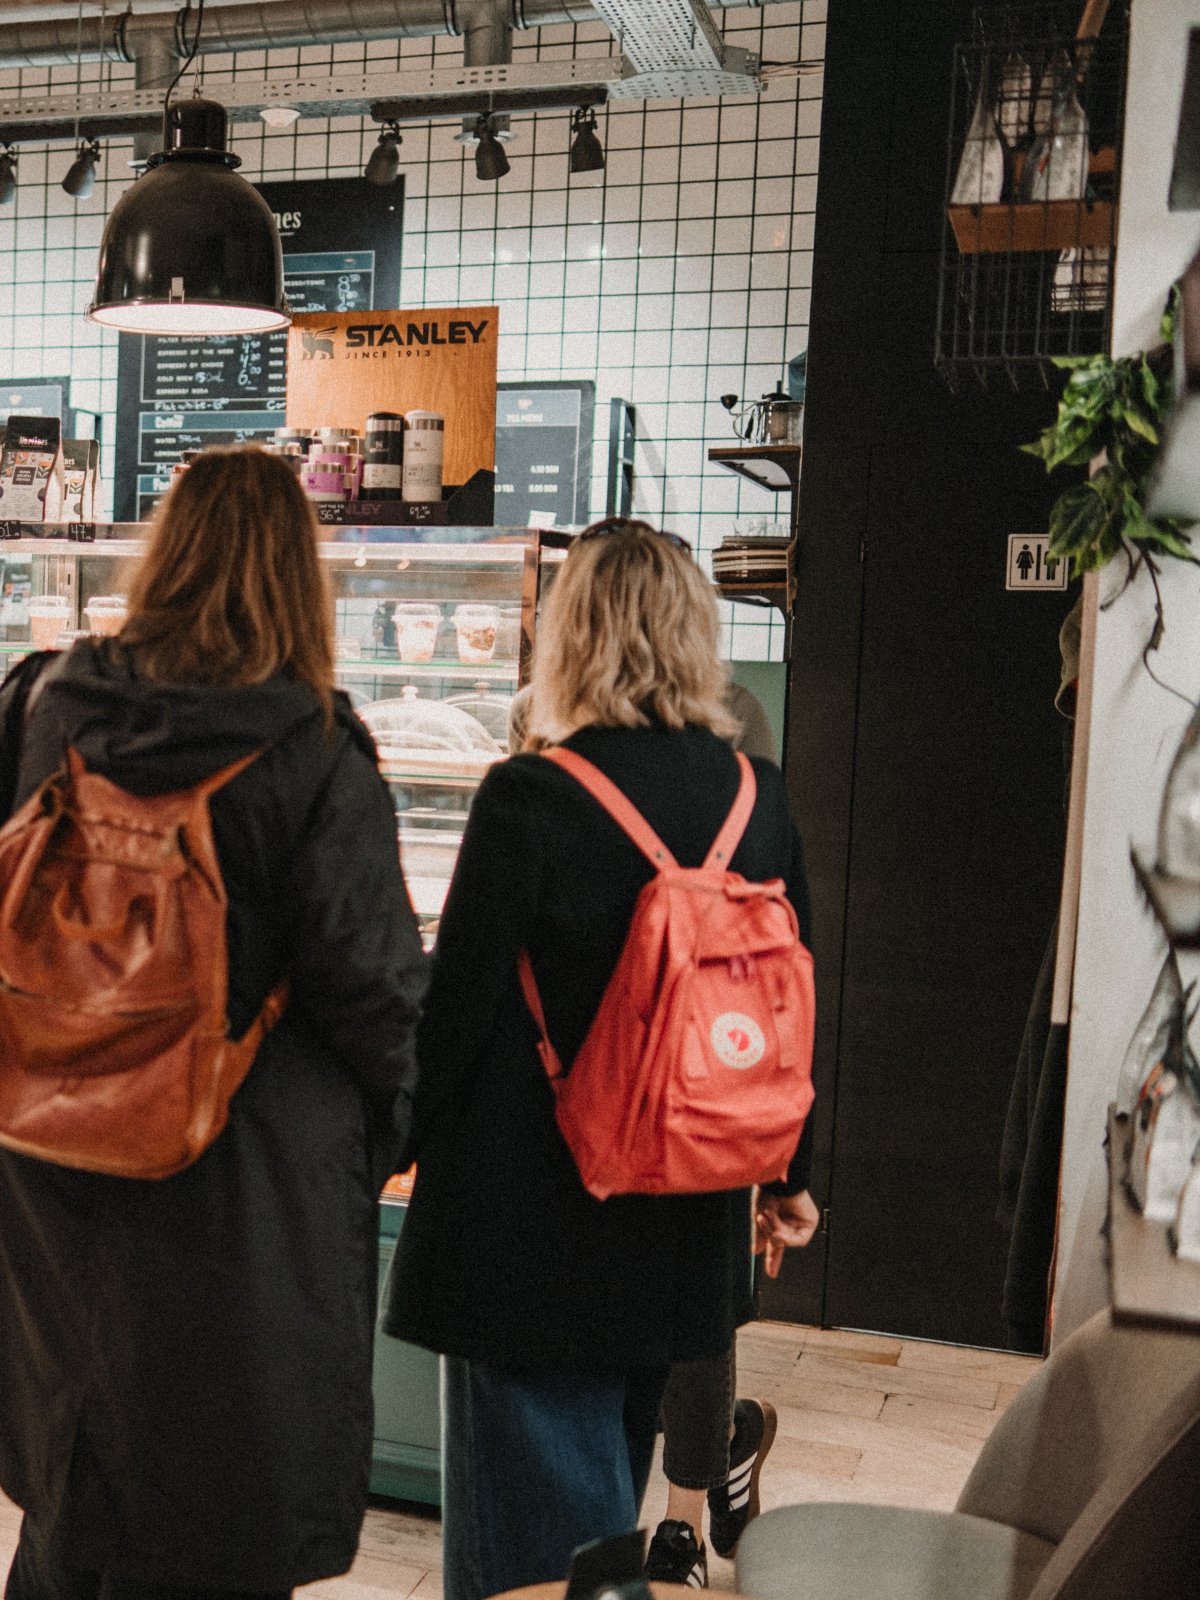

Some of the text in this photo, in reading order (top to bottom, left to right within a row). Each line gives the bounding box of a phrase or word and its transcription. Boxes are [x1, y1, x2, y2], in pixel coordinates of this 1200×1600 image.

[345, 320, 489, 348] STANLEY
[344, 349, 431, 360] SINCE 1913
